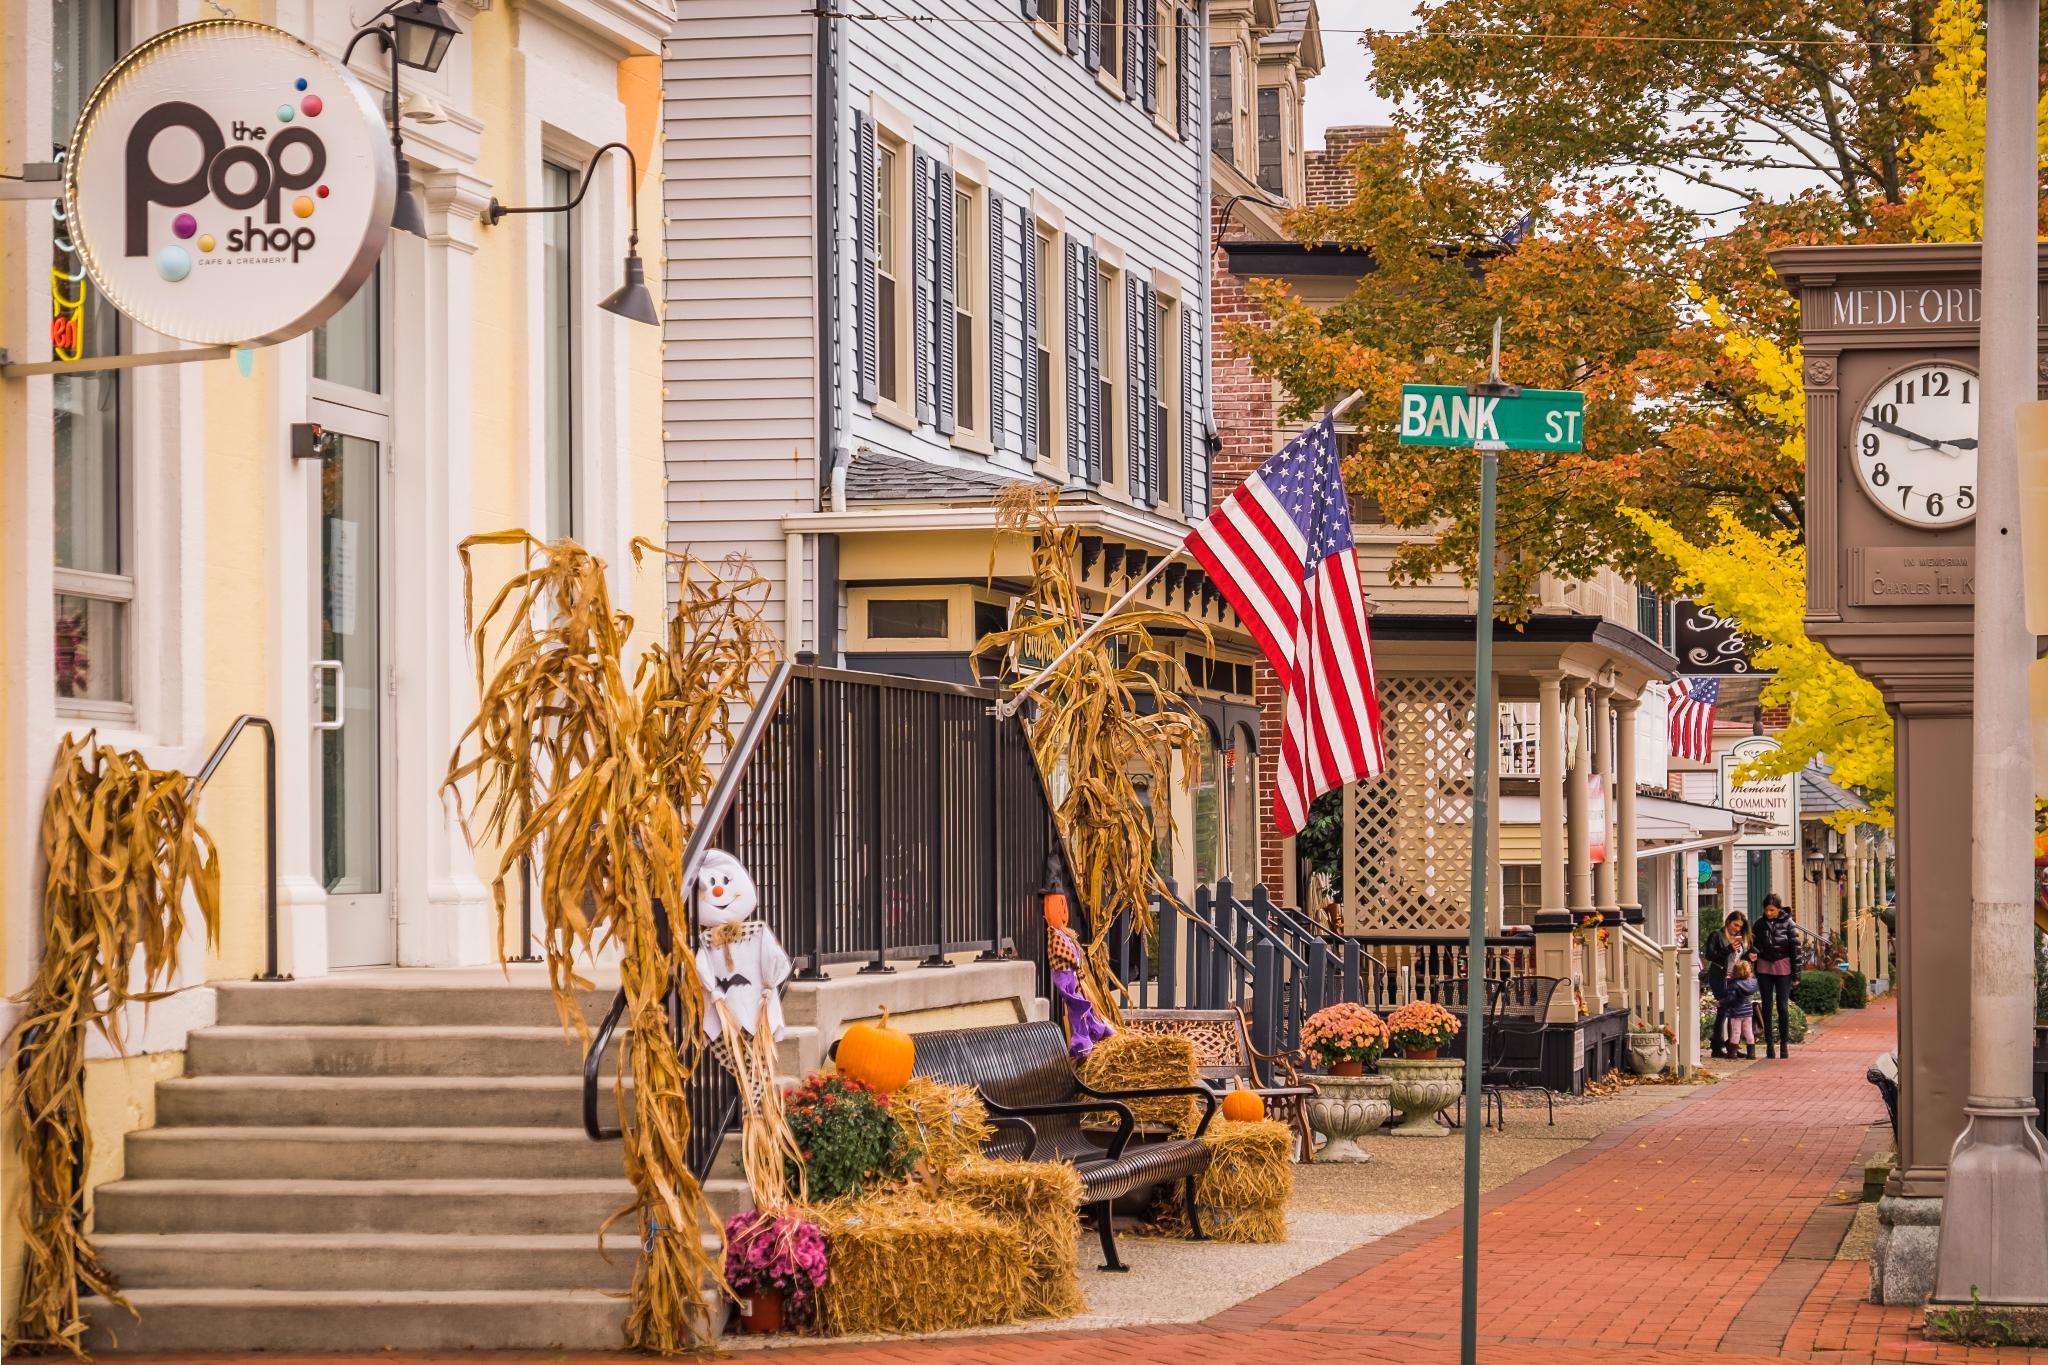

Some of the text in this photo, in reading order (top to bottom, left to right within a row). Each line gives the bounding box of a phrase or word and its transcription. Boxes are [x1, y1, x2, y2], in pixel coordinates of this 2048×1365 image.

[232, 121, 266, 141] the
[226, 216, 316, 263] shop
[236, 257, 288, 265] CREAMERY
[1833, 288, 1983, 325] MEDFORD
[1895, 380, 1915, 405] 11
[1921, 371, 1950, 397] 12
[1962, 379, 1971, 404] 1
[1402, 393, 1581, 443] BANK ST
[1872, 403, 1898, 427] 10
[1862, 433, 1880, 457] 9
[1872, 462, 1890, 487] 8
[1897, 485, 1913, 511] 7
[1926, 492, 1944, 517] 6
[1956, 485, 1975, 509] 5
[1730, 784, 1787, 793] Memorial
[1729, 797, 1788, 809] COMMUNITY
